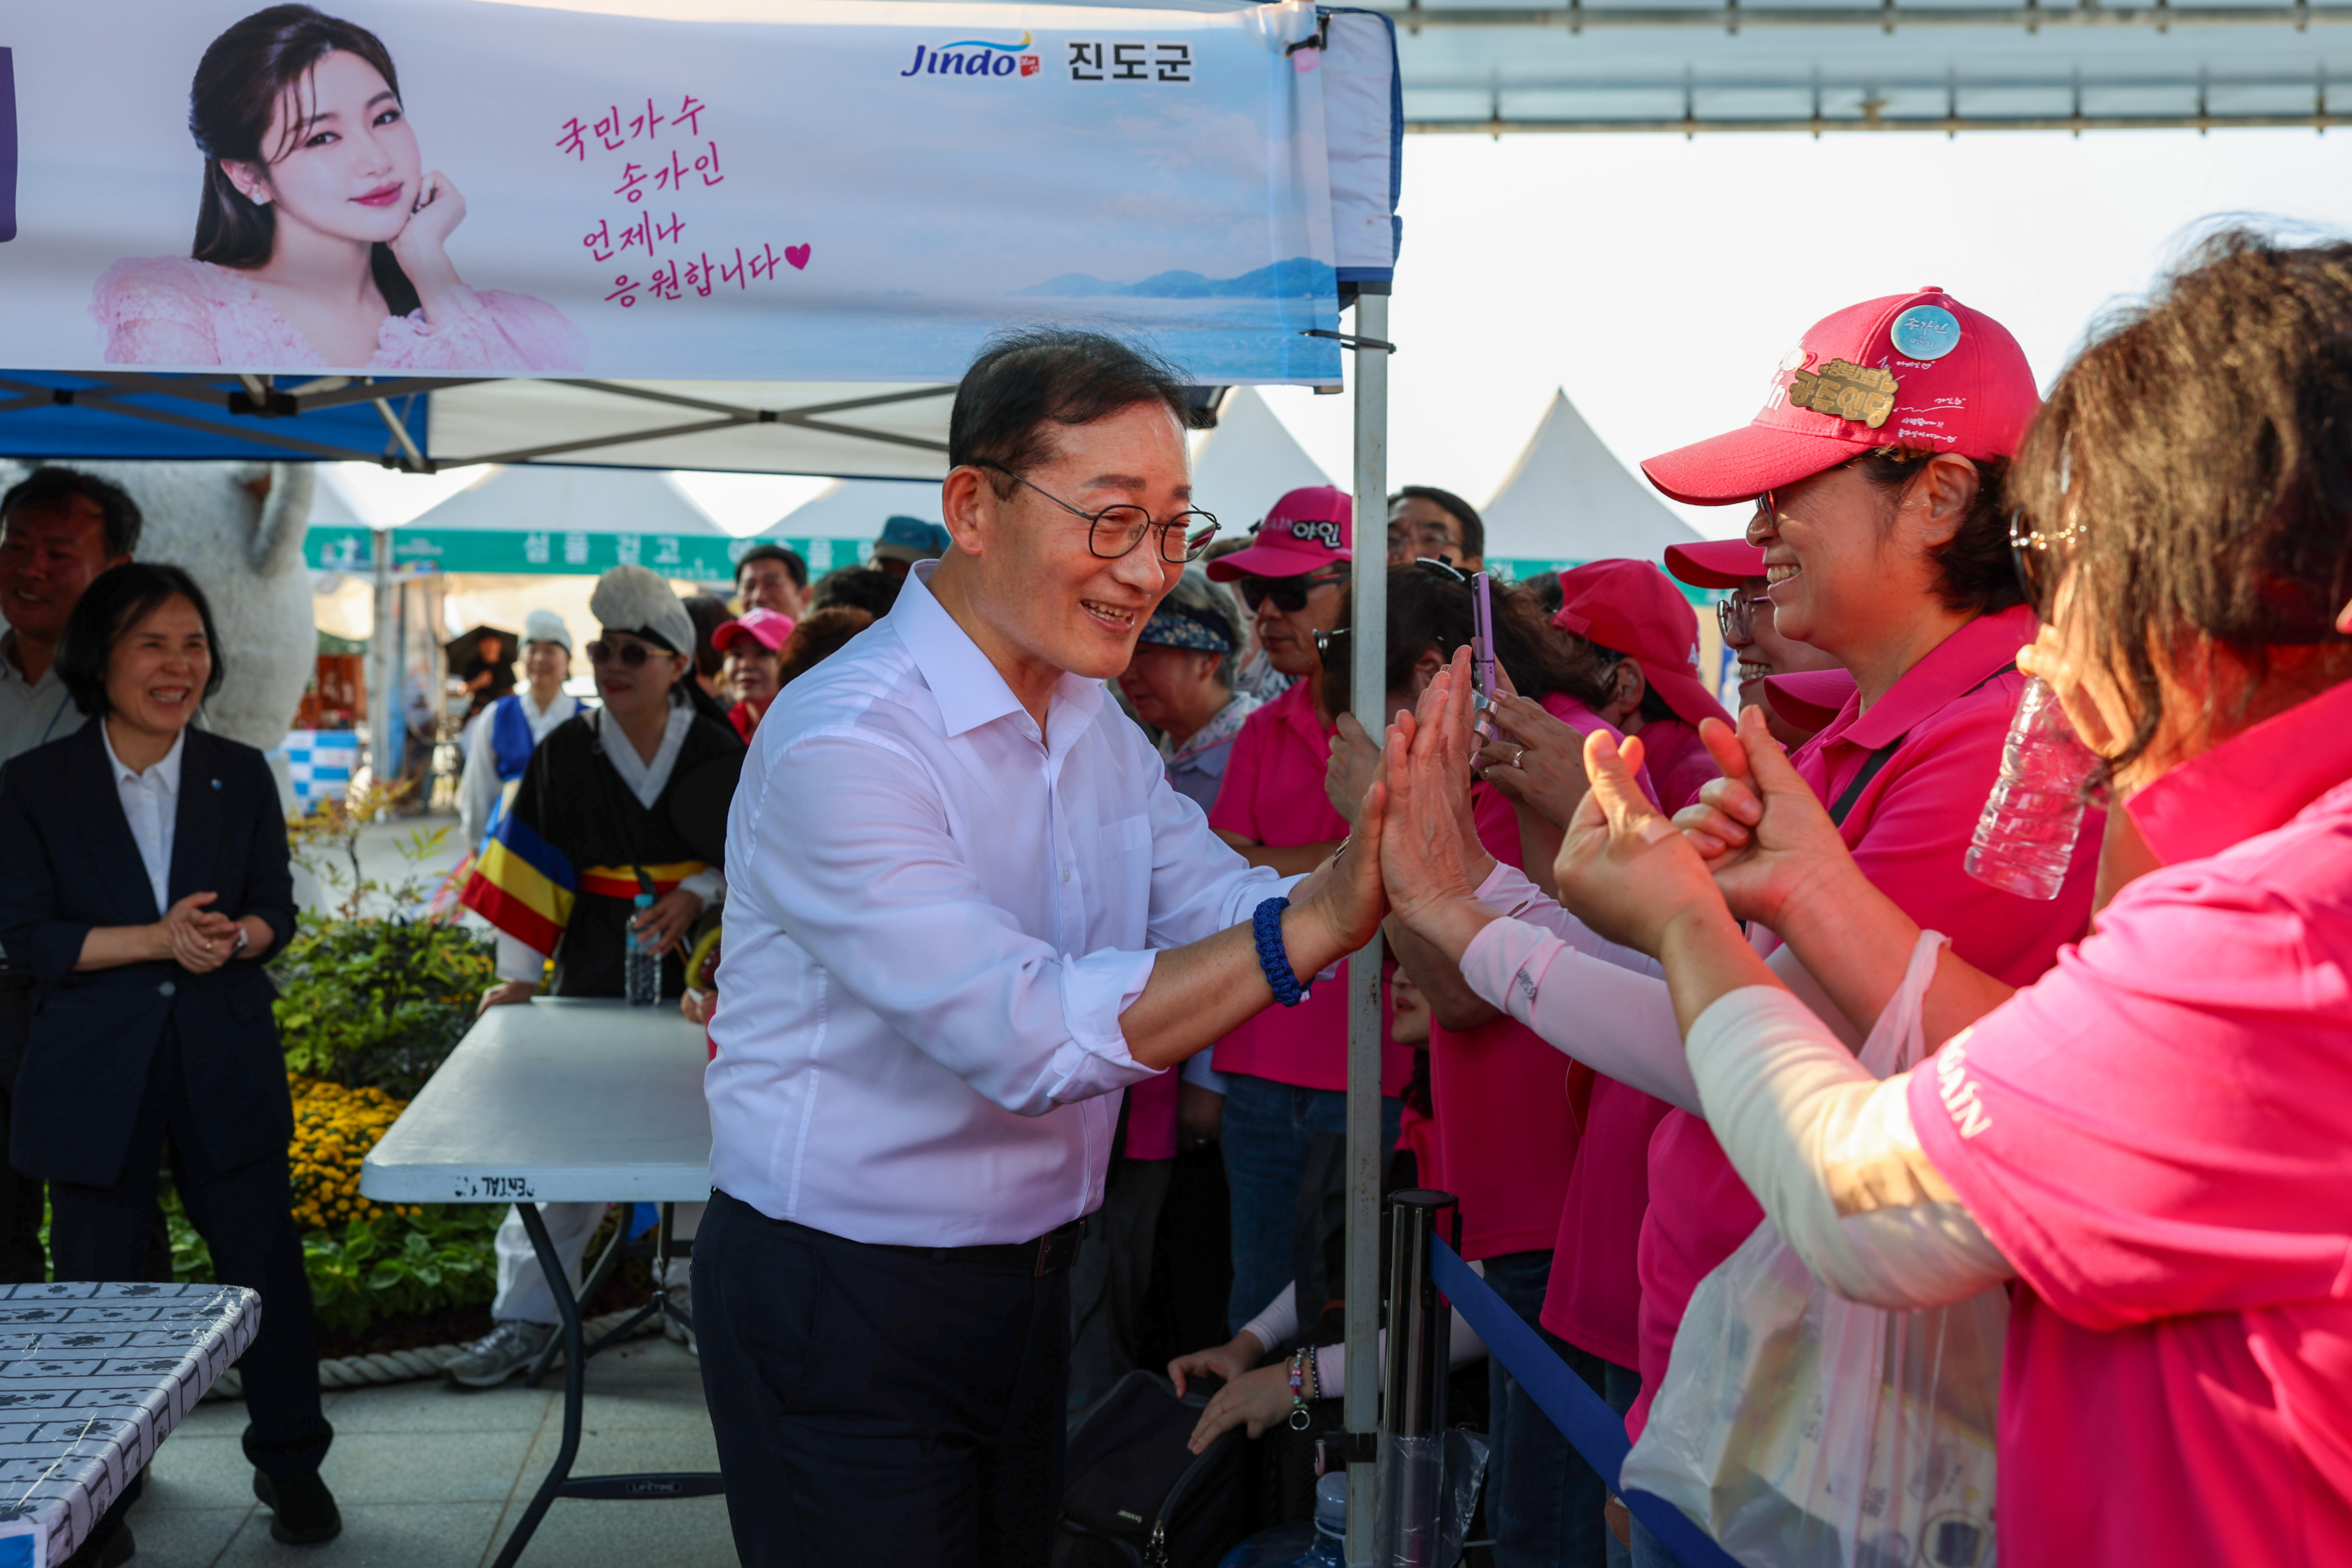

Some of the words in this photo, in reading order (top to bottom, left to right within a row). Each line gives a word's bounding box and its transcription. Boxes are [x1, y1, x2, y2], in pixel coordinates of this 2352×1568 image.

[901, 45, 1015, 76] Jindo
[1069, 43, 1191, 81] 진도군
[555, 95, 705, 161] 국민가수
[614, 141, 724, 203] 송가인
[583, 210, 686, 262] 언제나
[604, 243, 780, 308] 응원합니다
[1904, 317, 1949, 336] 송가인
